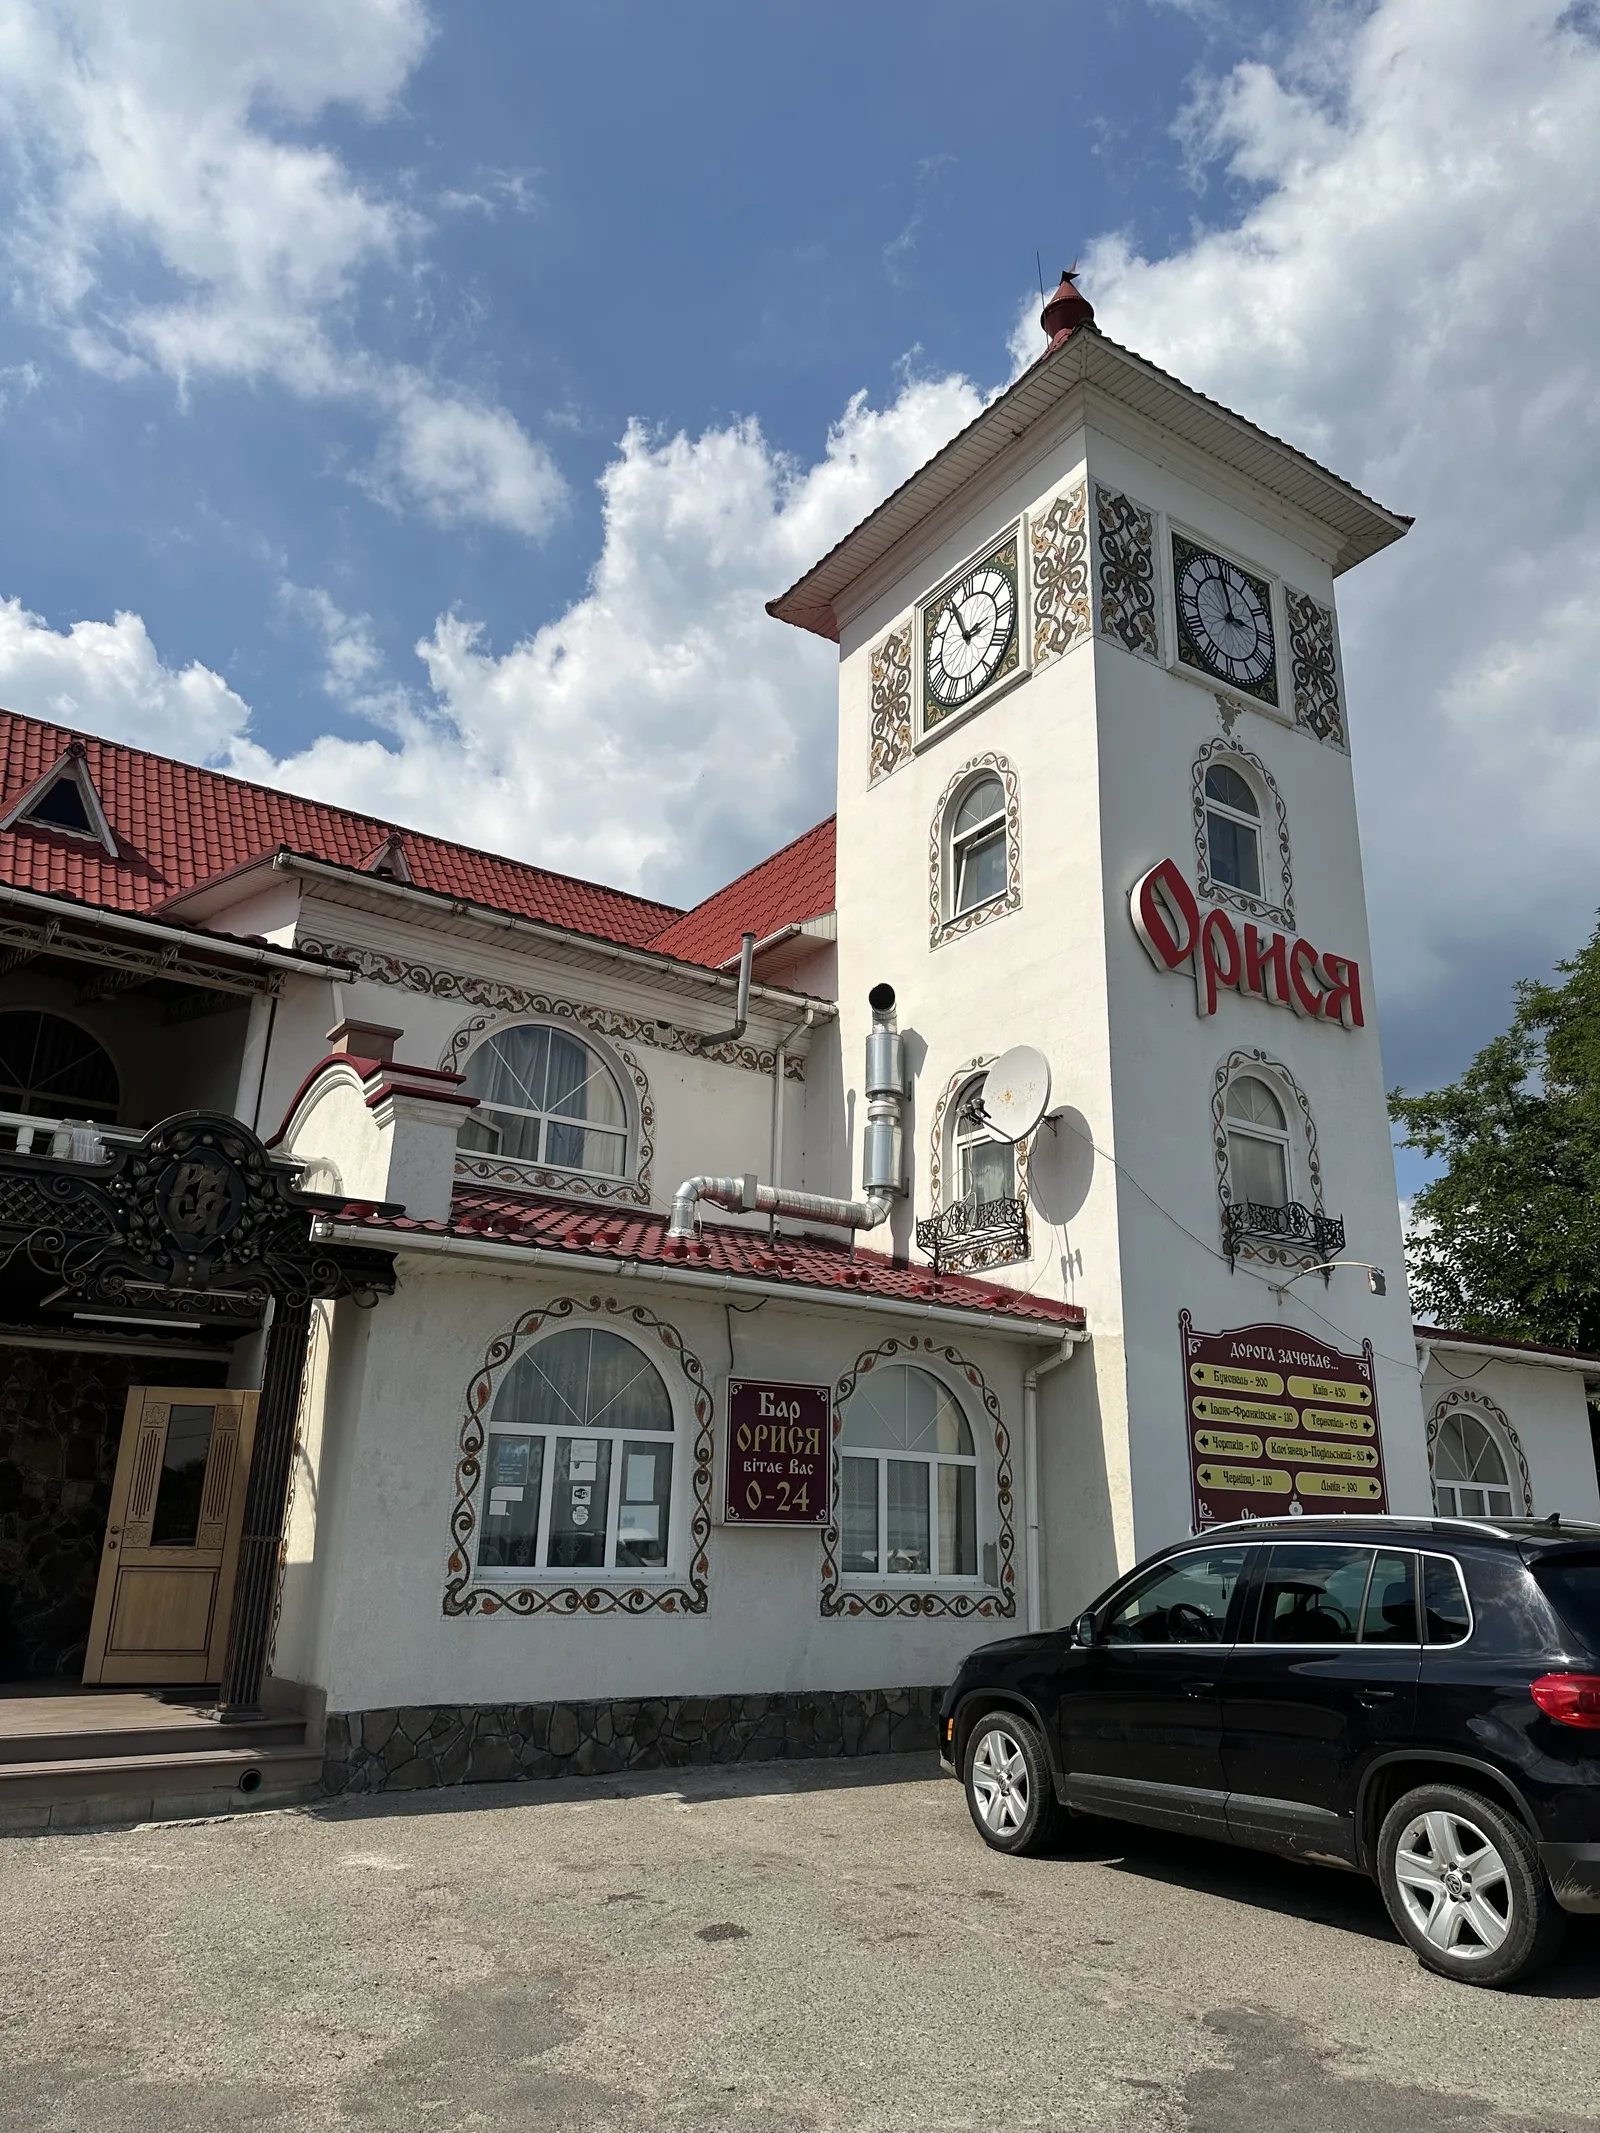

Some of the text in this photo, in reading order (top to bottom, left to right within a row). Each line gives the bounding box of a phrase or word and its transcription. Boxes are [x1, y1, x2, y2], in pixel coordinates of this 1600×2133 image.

[1133, 858, 1365, 1028] Орися
[1230, 1342, 1275, 1361] ДОРОГА
[1213, 1369, 1248, 1385] Буковель
[1255, 1376, 1268, 1387] 200
[1312, 1383, 1328, 1396] Київ
[1334, 1386, 1347, 1398] 450
[758, 1391, 801, 1426] Бар
[1210, 1402, 1277, 1421] Івано-Франківськ
[1284, 1412, 1293, 1422] 110
[1310, 1413, 1344, 1428] Тернопіль
[1350, 1418, 1358, 1429] 65
[736, 1422, 821, 1455] ОРИСЯ
[1212, 1435, 1244, 1451] Чортків
[1251, 1441, 1259, 1451] 10
[1356, 1451, 1365, 1461] 85
[743, 1457, 814, 1475] вітає Вас
[1222, 1470, 1255, 1486] Чернівці
[1262, 1475, 1272, 1486] 110
[1321, 1479, 1340, 1492] Львів
[1347, 1482, 1357, 1493] 190
[745, 1479, 810, 1512] 0-24
